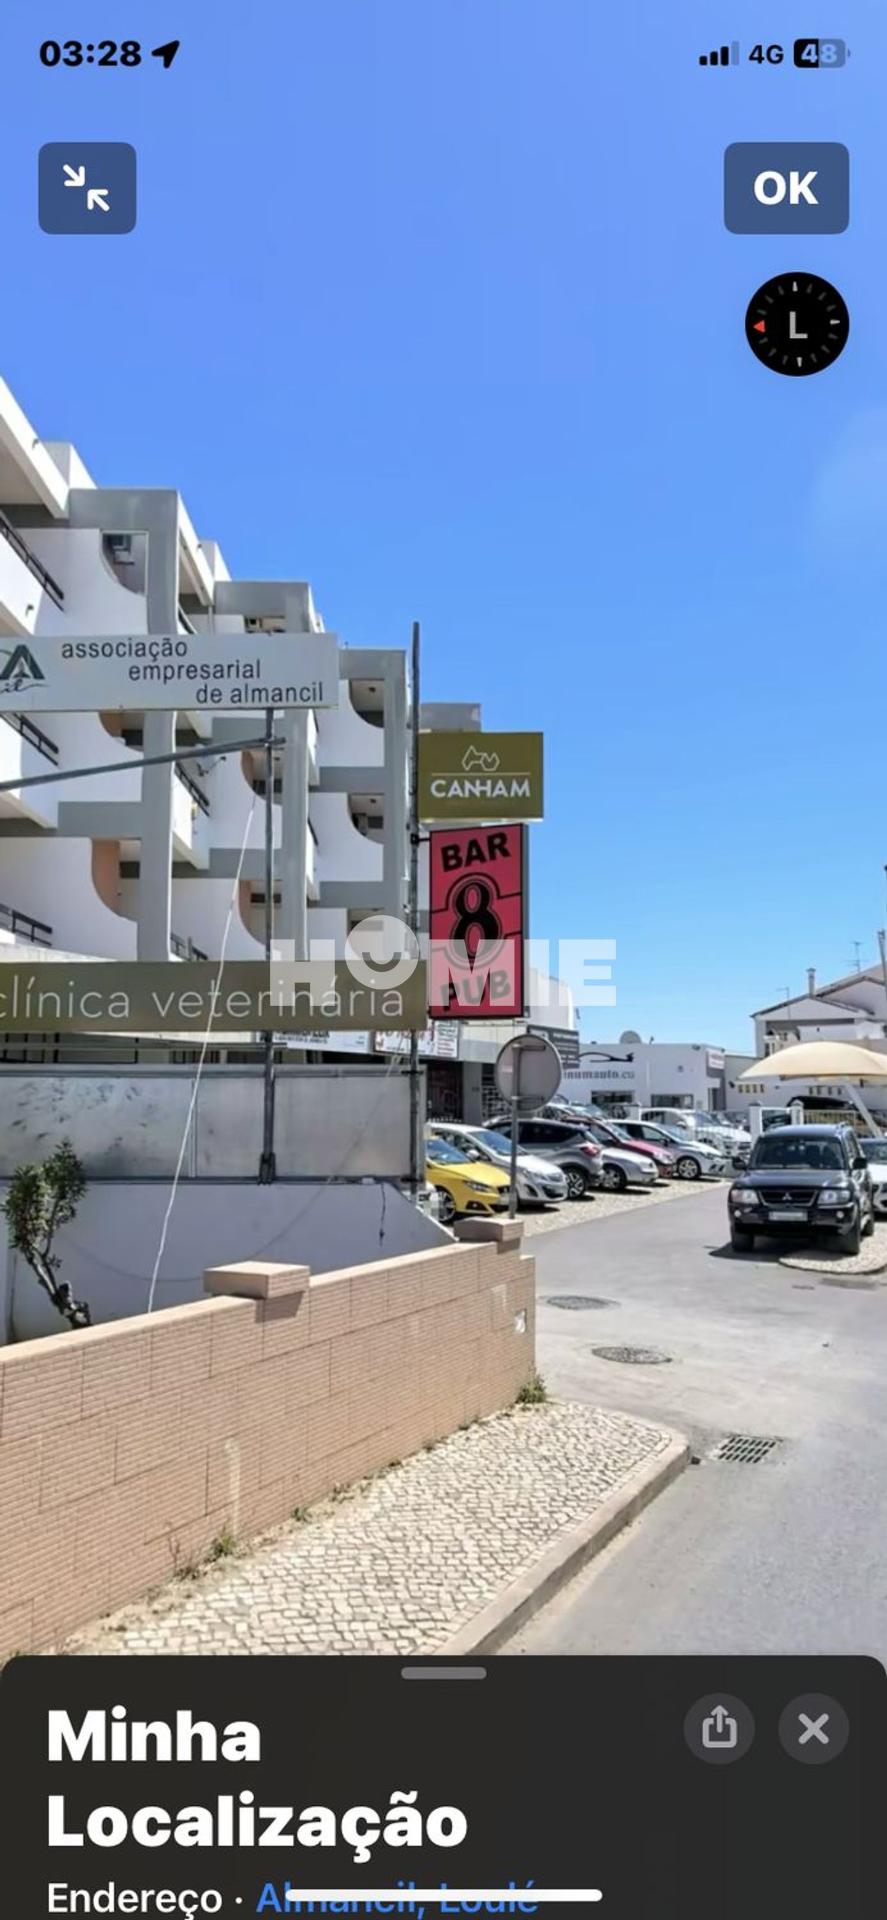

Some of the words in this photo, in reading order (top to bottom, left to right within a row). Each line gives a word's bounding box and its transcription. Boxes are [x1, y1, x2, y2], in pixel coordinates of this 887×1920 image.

[61, 638, 188, 662] associação
[128, 659, 261, 684] empresarial
[196, 684, 222, 704] de
[230, 681, 324, 704] almancil
[430, 779, 531, 798] CANHAM
[440, 831, 511, 873] BAR
[451, 878, 502, 964] 8
[152, 974, 404, 1018] veterinária
[440, 969, 512, 1013] PUB
